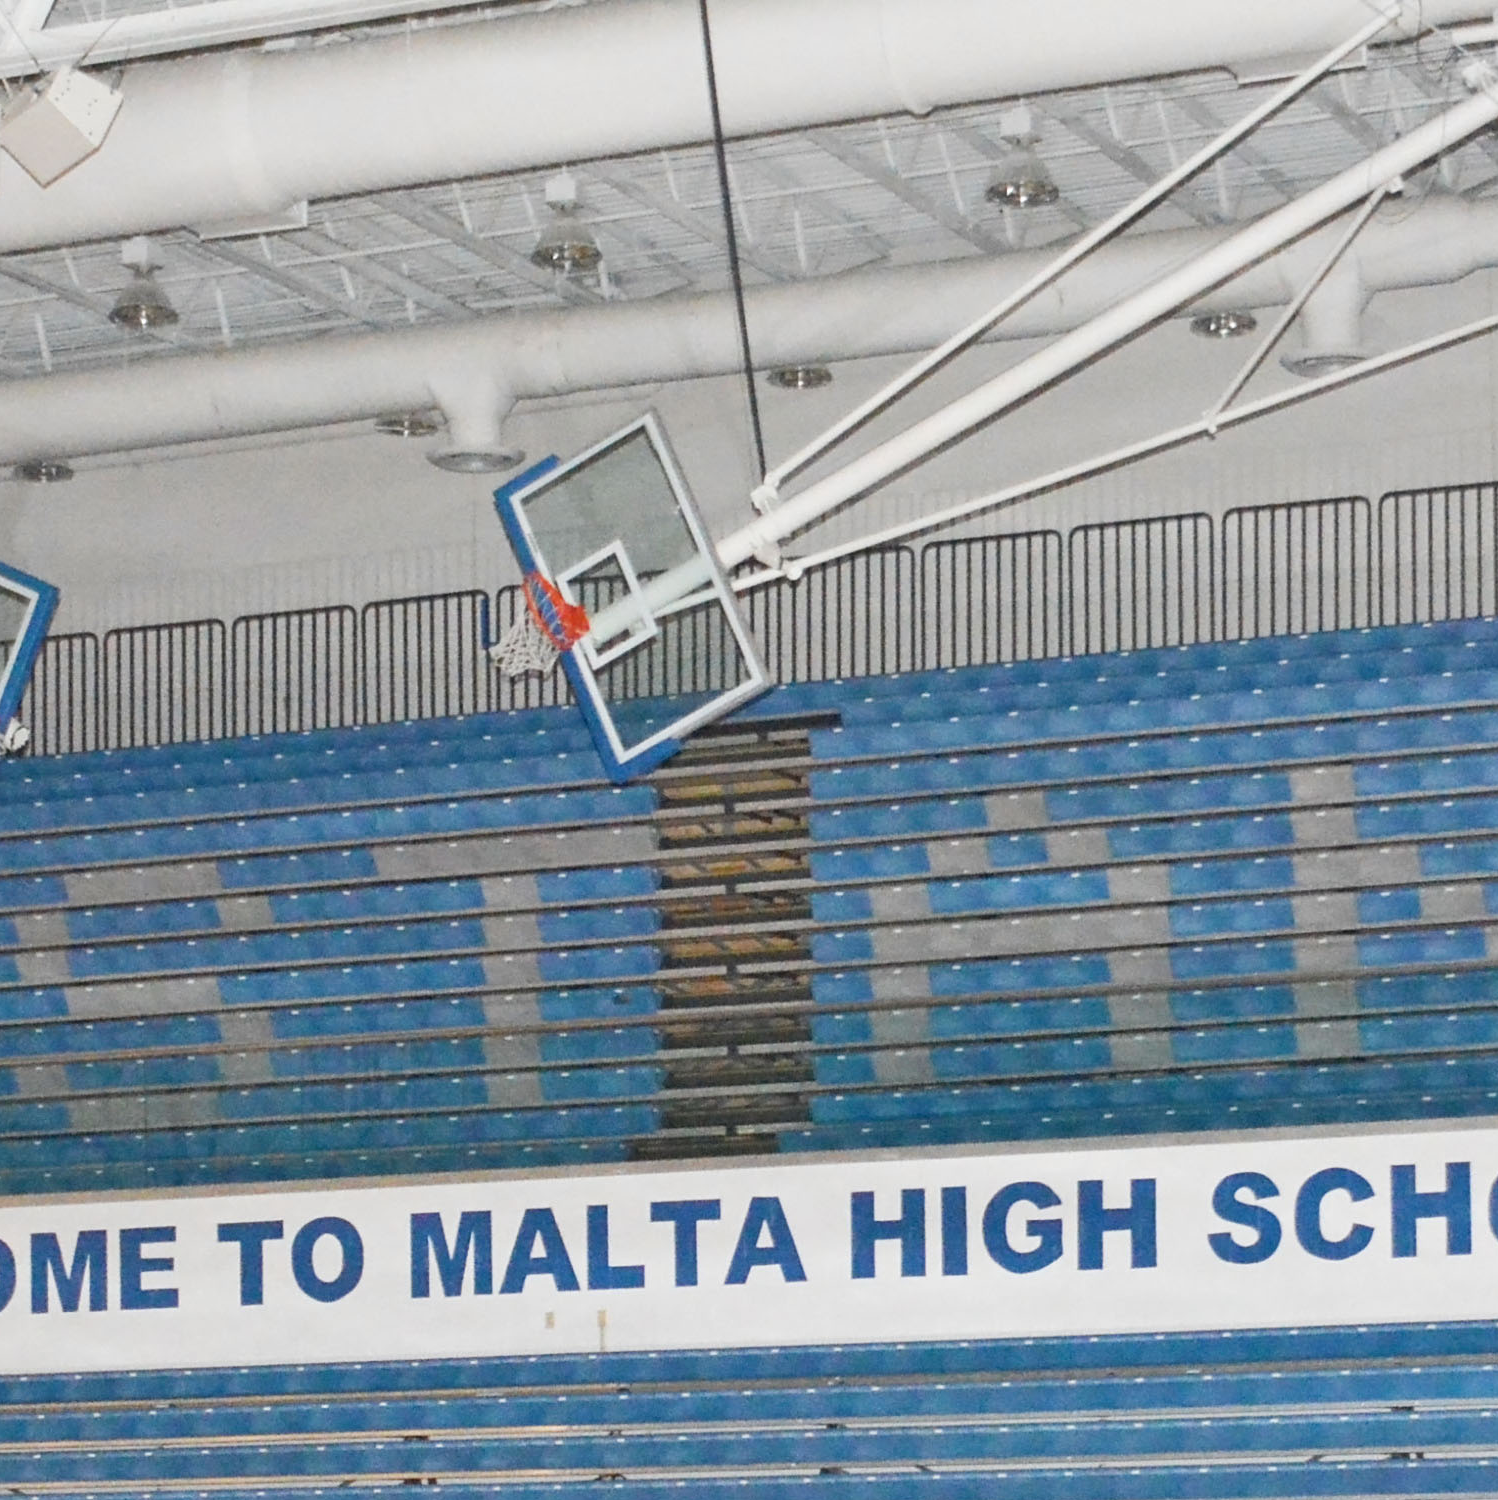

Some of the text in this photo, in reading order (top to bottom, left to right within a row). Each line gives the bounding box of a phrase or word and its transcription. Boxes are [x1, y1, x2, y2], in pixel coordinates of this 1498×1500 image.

[217, 1216, 364, 1306] TO
[409, 1196, 807, 1299] MALTA
[850, 1178, 1158, 1280] HIGH
